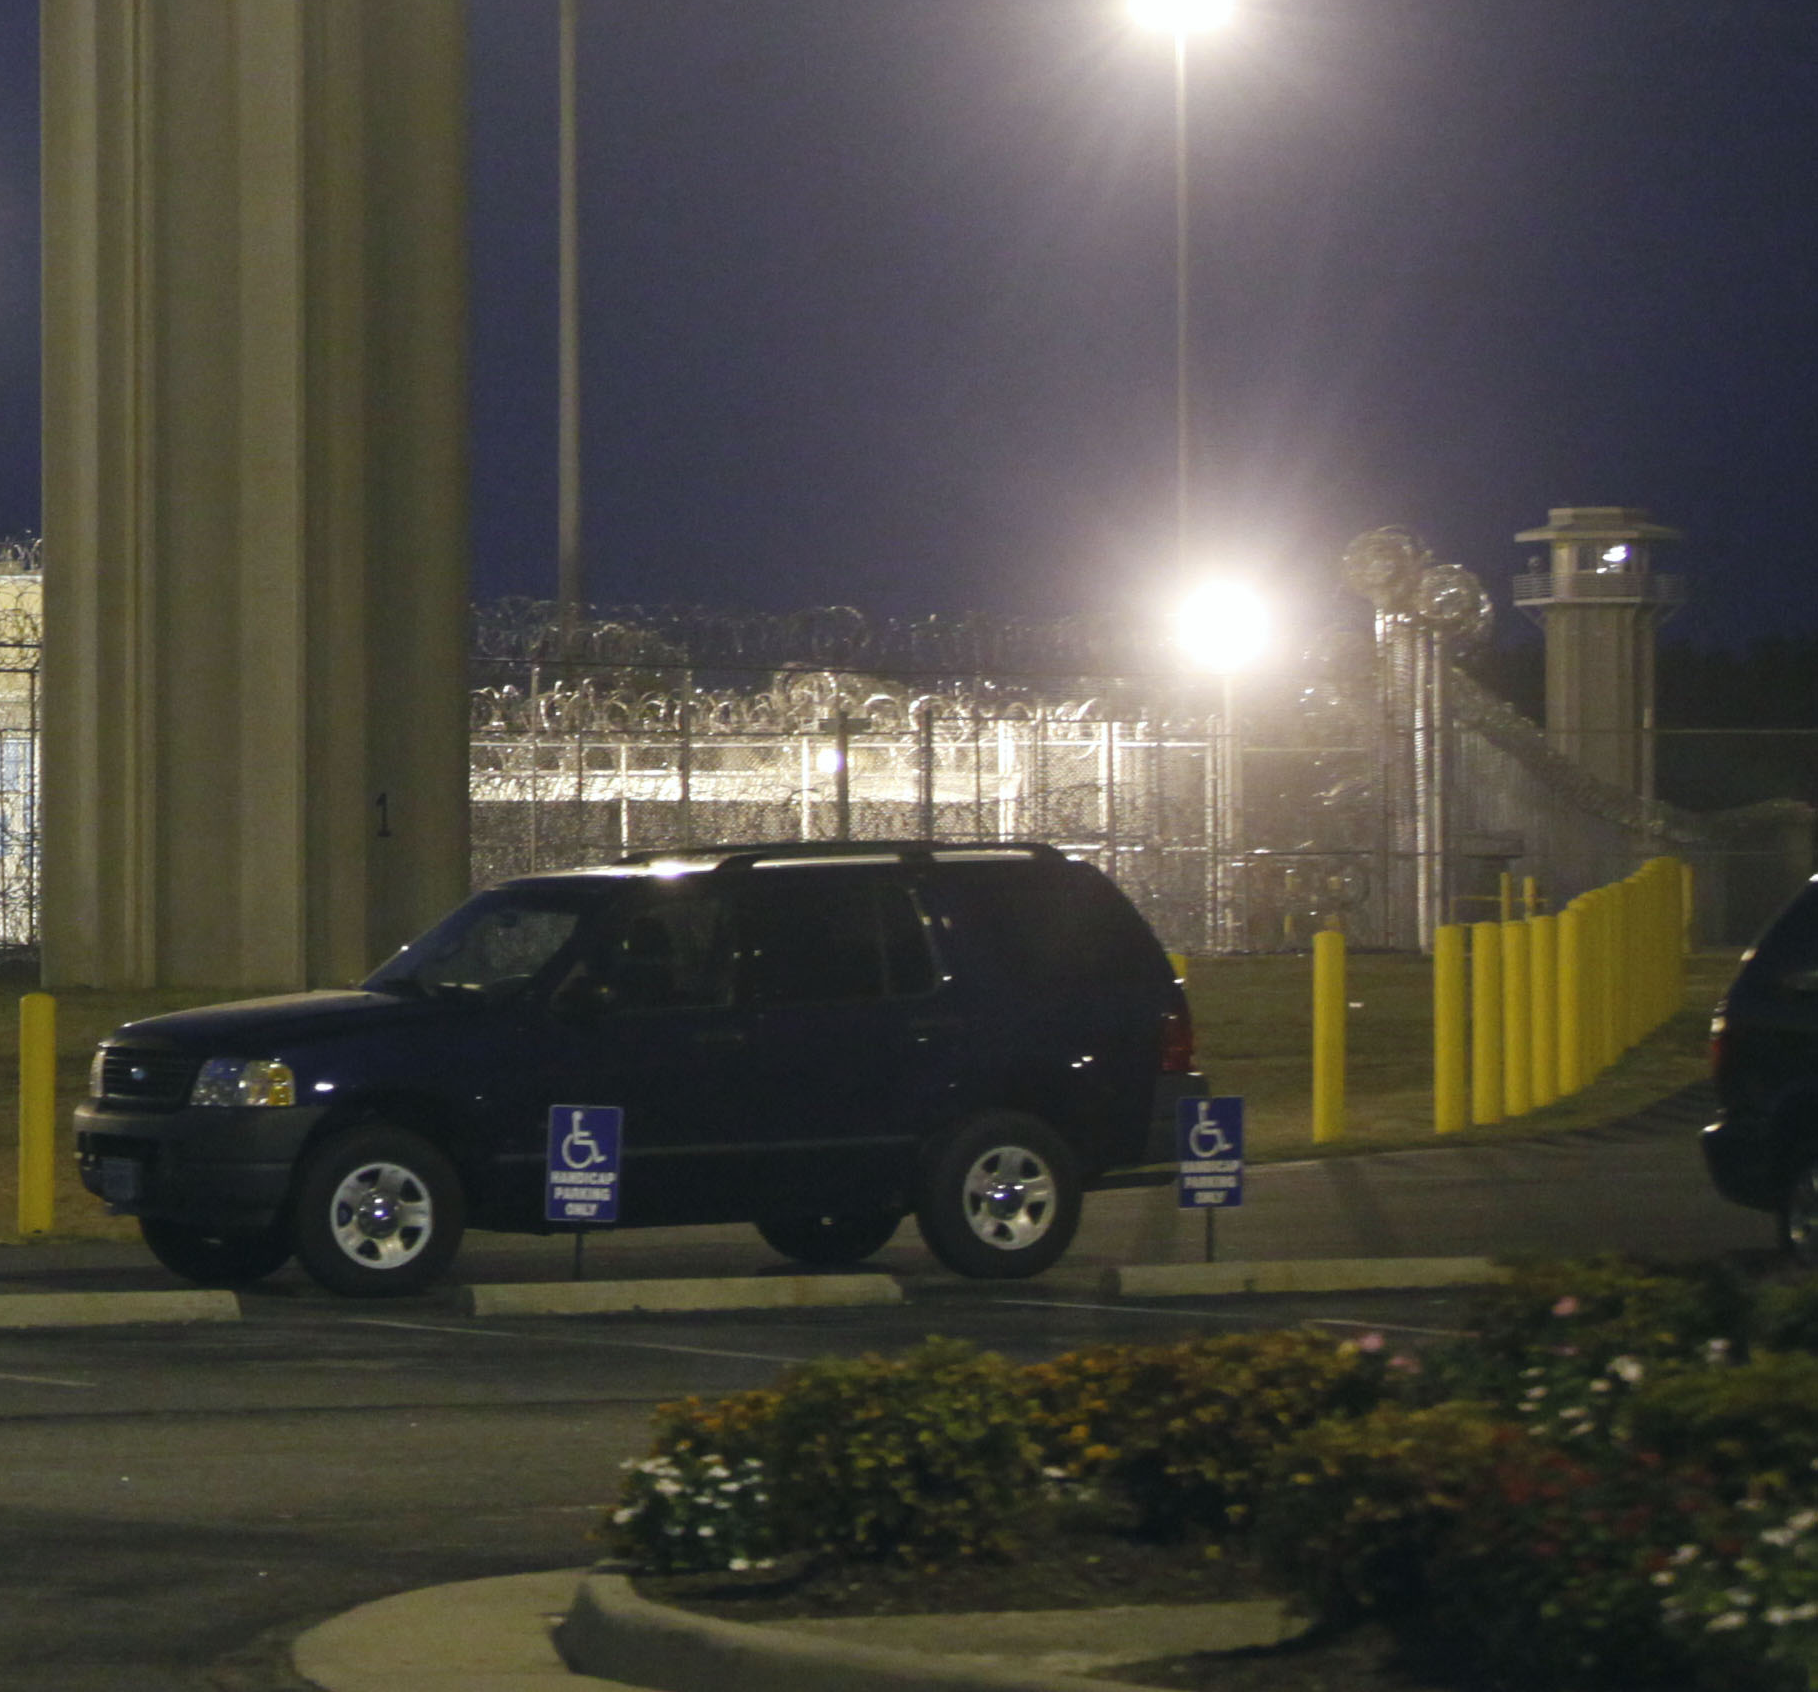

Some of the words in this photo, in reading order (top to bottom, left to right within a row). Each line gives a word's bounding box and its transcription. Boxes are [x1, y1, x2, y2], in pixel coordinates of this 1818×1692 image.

[550, 1172, 616, 1185] HANDICAP
[554, 1187, 611, 1201] PARKING
[565, 1203, 599, 1217] ONLY
